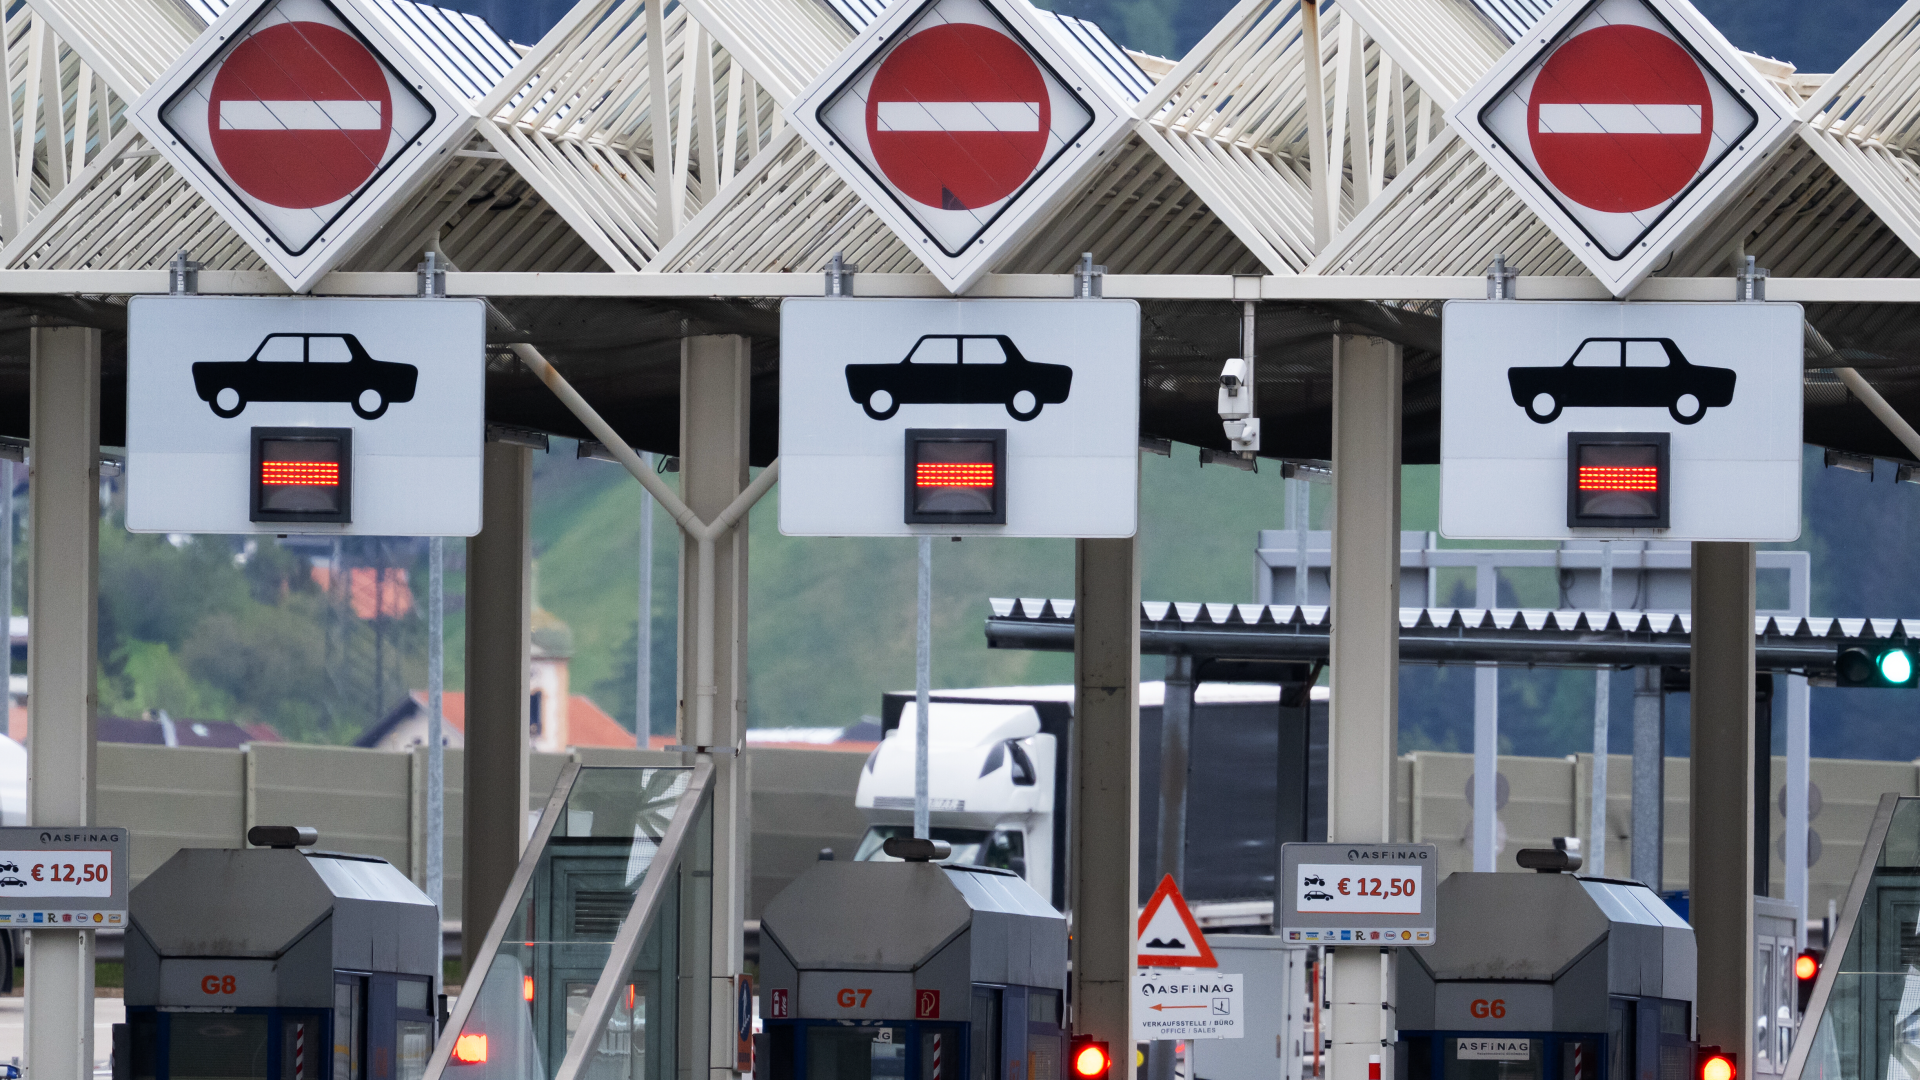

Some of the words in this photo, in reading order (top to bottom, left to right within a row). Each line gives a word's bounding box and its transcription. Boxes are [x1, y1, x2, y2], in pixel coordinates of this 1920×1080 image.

[31, 863, 44, 882] €
[50, 863, 108, 885] 12,50
[1337, 877, 1351, 896] €
[1357, 877, 1416, 900] 12,50
[201, 975, 237, 995] G8
[837, 988, 872, 1008] G7
[1470, 998, 1506, 1019] G6
